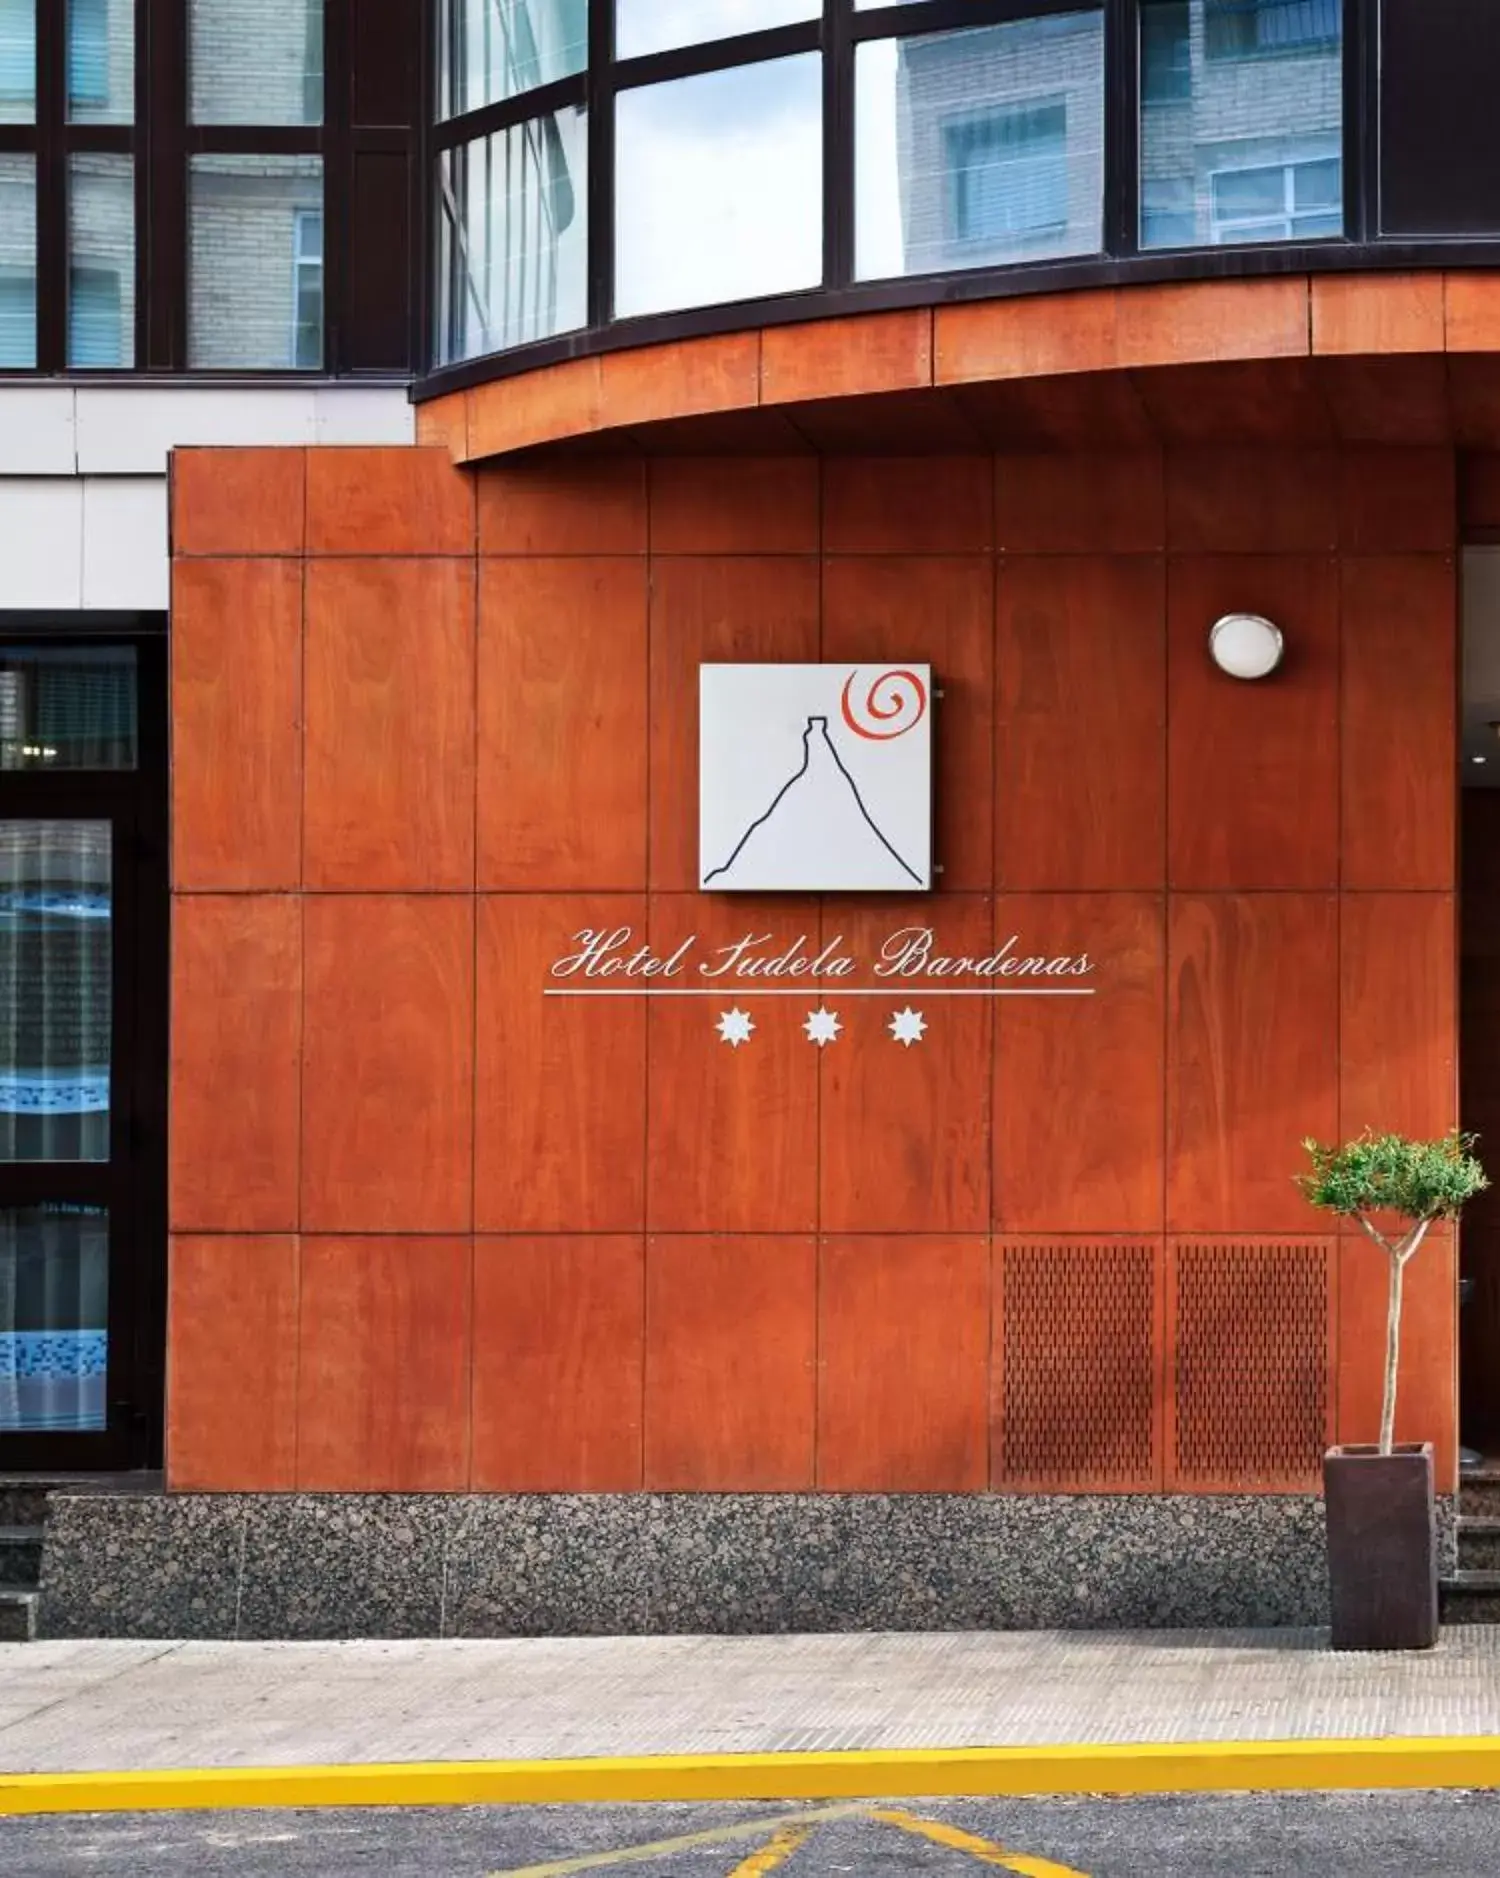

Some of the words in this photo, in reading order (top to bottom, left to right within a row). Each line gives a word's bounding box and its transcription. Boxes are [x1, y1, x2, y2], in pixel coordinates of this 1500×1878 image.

[551, 925, 696, 977] Hotel
[699, 932, 856, 977] Tudela
[873, 926, 1096, 977] Bardenas
